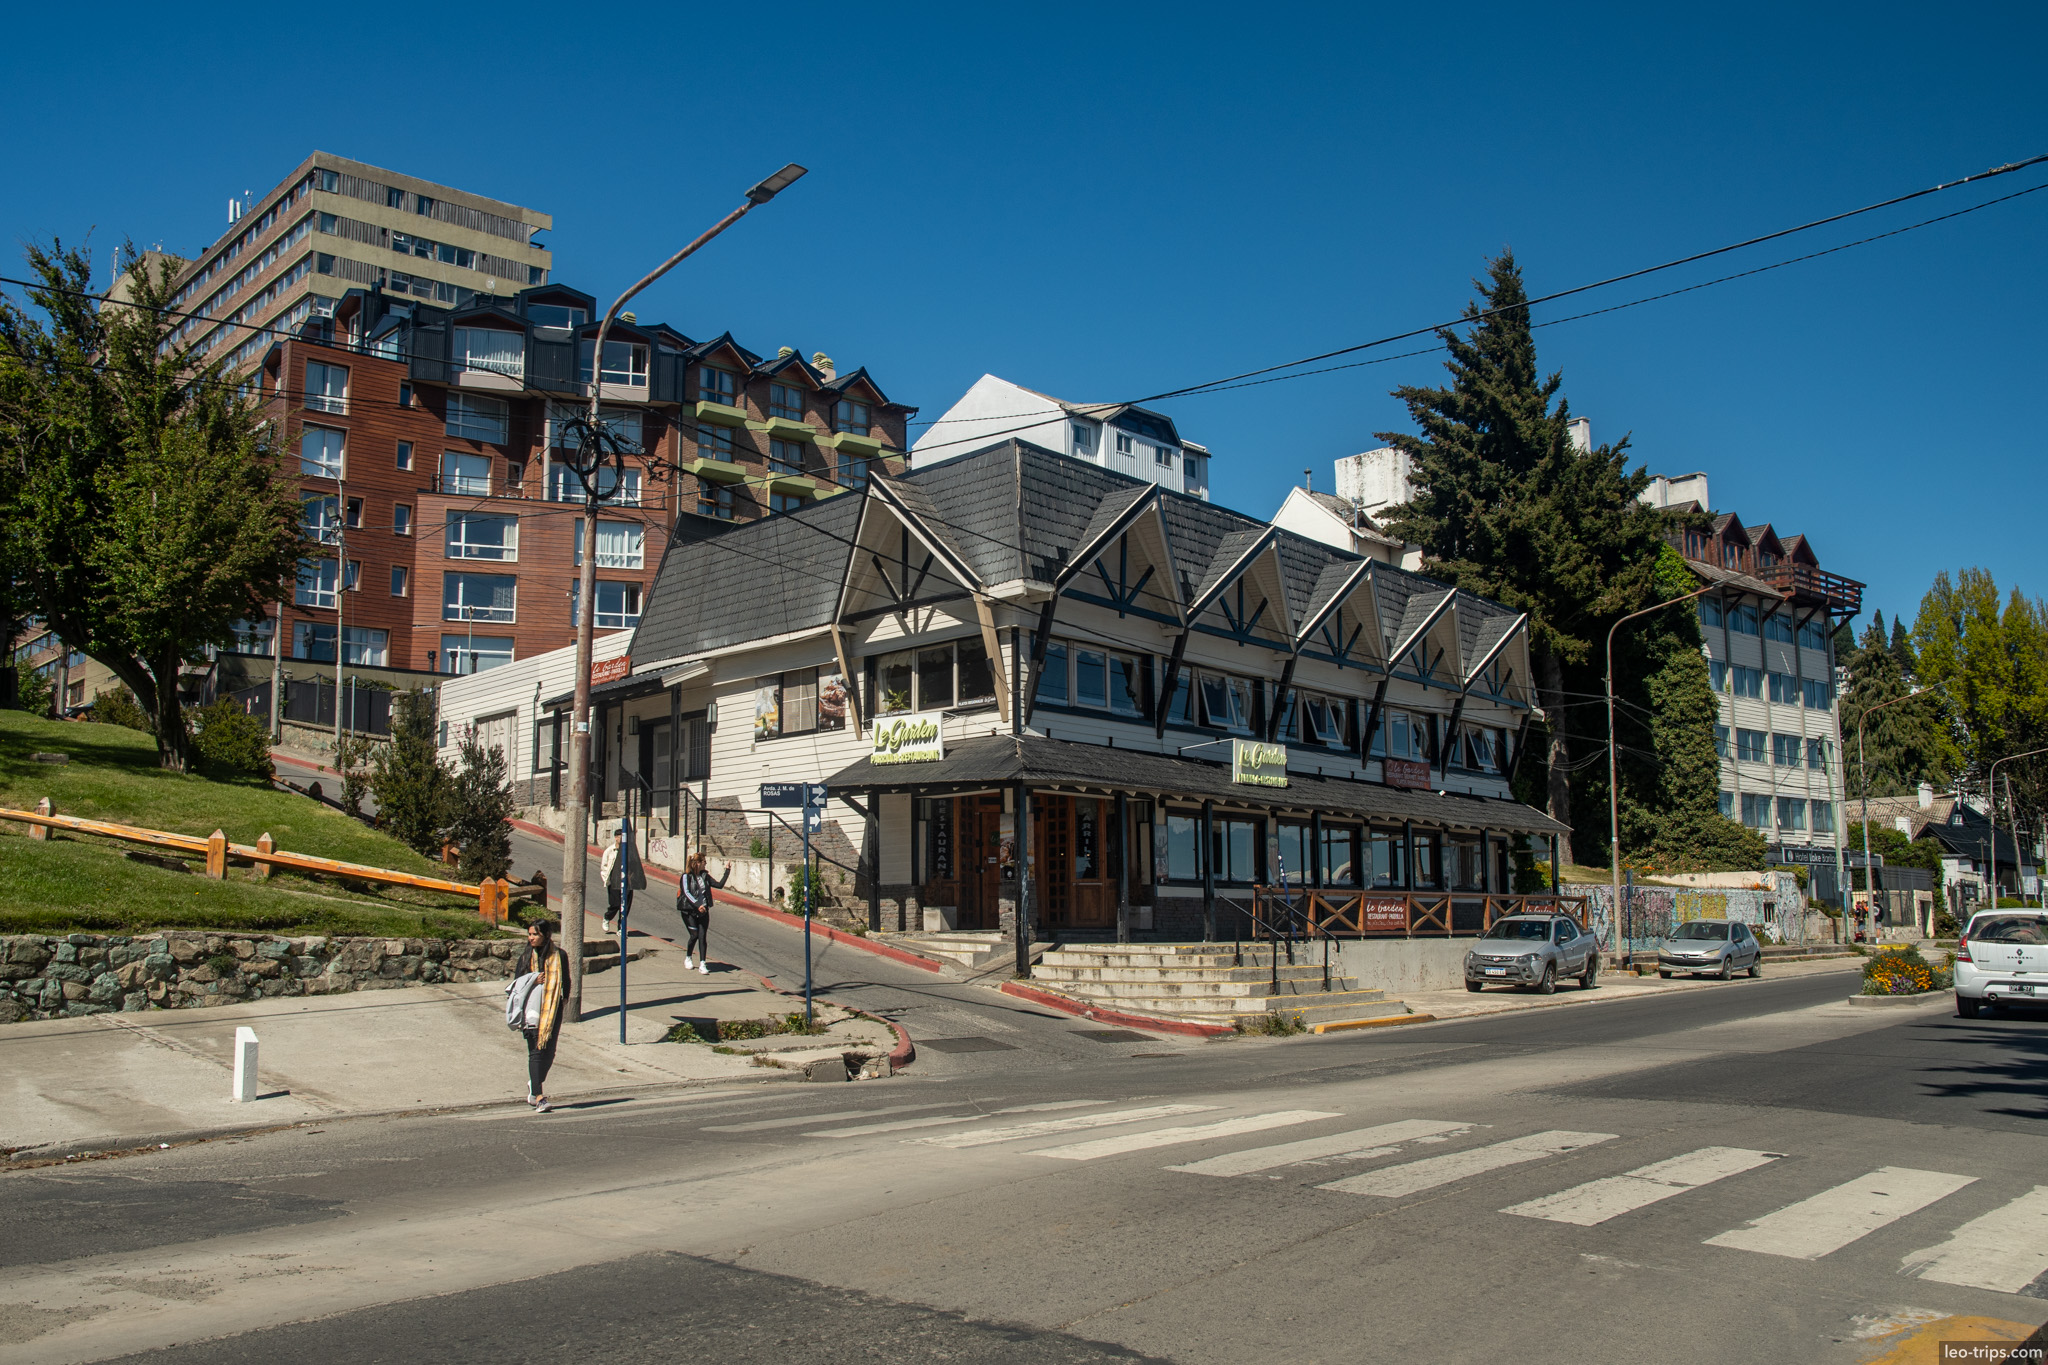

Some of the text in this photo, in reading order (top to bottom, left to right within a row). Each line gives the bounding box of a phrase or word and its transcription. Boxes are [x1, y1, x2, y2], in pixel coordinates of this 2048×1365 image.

[873, 718, 939, 749] Le Garden
[1238, 743, 1287, 769] Le Garden
[937, 799, 947, 876] RESTAURANT
[1795, 852, 1808, 862] Hotel
[1810, 853, 1821, 862] Lake
[1377, 900, 1405, 913] Garden
